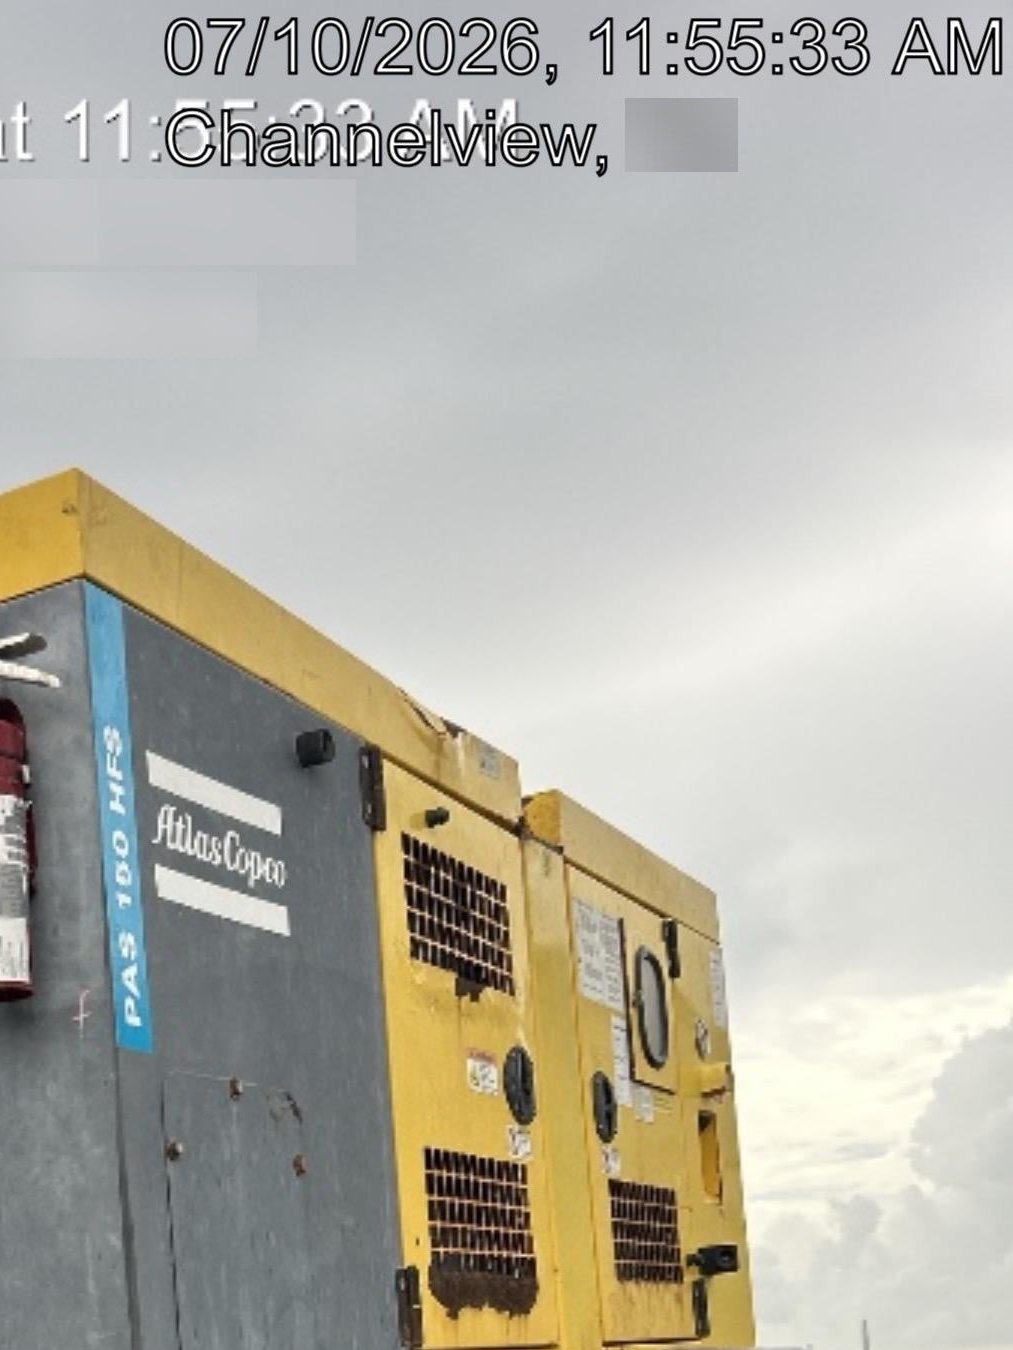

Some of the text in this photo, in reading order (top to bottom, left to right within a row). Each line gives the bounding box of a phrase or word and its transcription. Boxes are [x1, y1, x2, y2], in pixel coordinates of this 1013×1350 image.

[150, 803, 286, 889] Atlas Copco
[118, 931, 142, 1027] PAS
